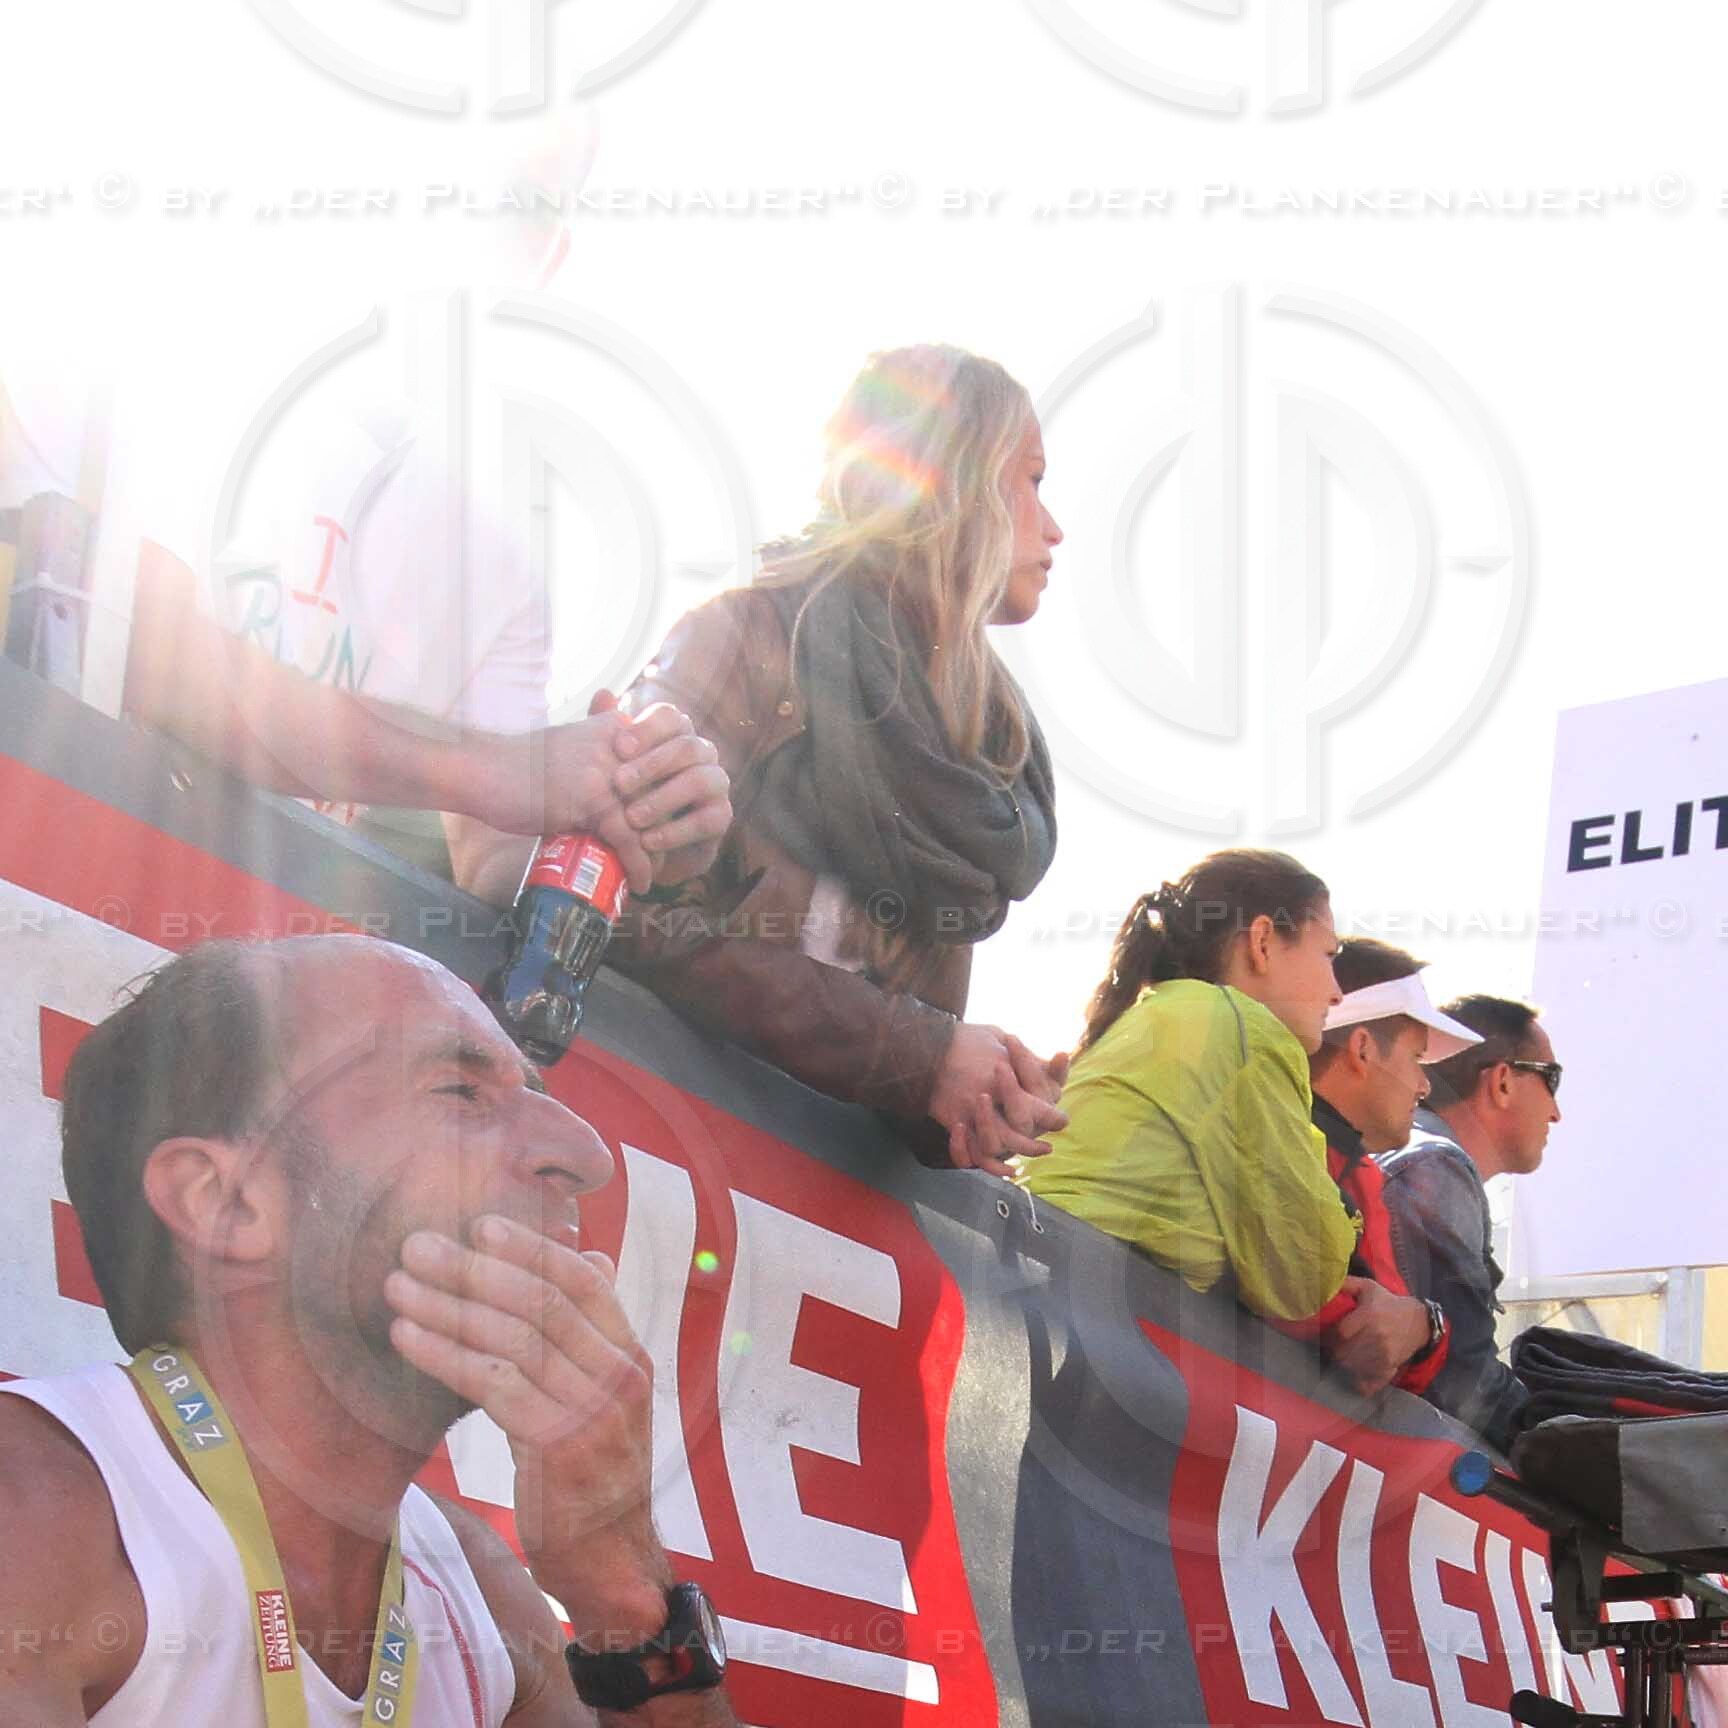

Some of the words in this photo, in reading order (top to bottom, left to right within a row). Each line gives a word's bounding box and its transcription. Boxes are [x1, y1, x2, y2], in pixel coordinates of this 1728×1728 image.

[151, 1353, 224, 1447] GRAZ
[258, 1594, 275, 1669] ZEITUNG
[270, 1593, 292, 1668] KLEINE
[375, 1607, 407, 1721] GRAZ
